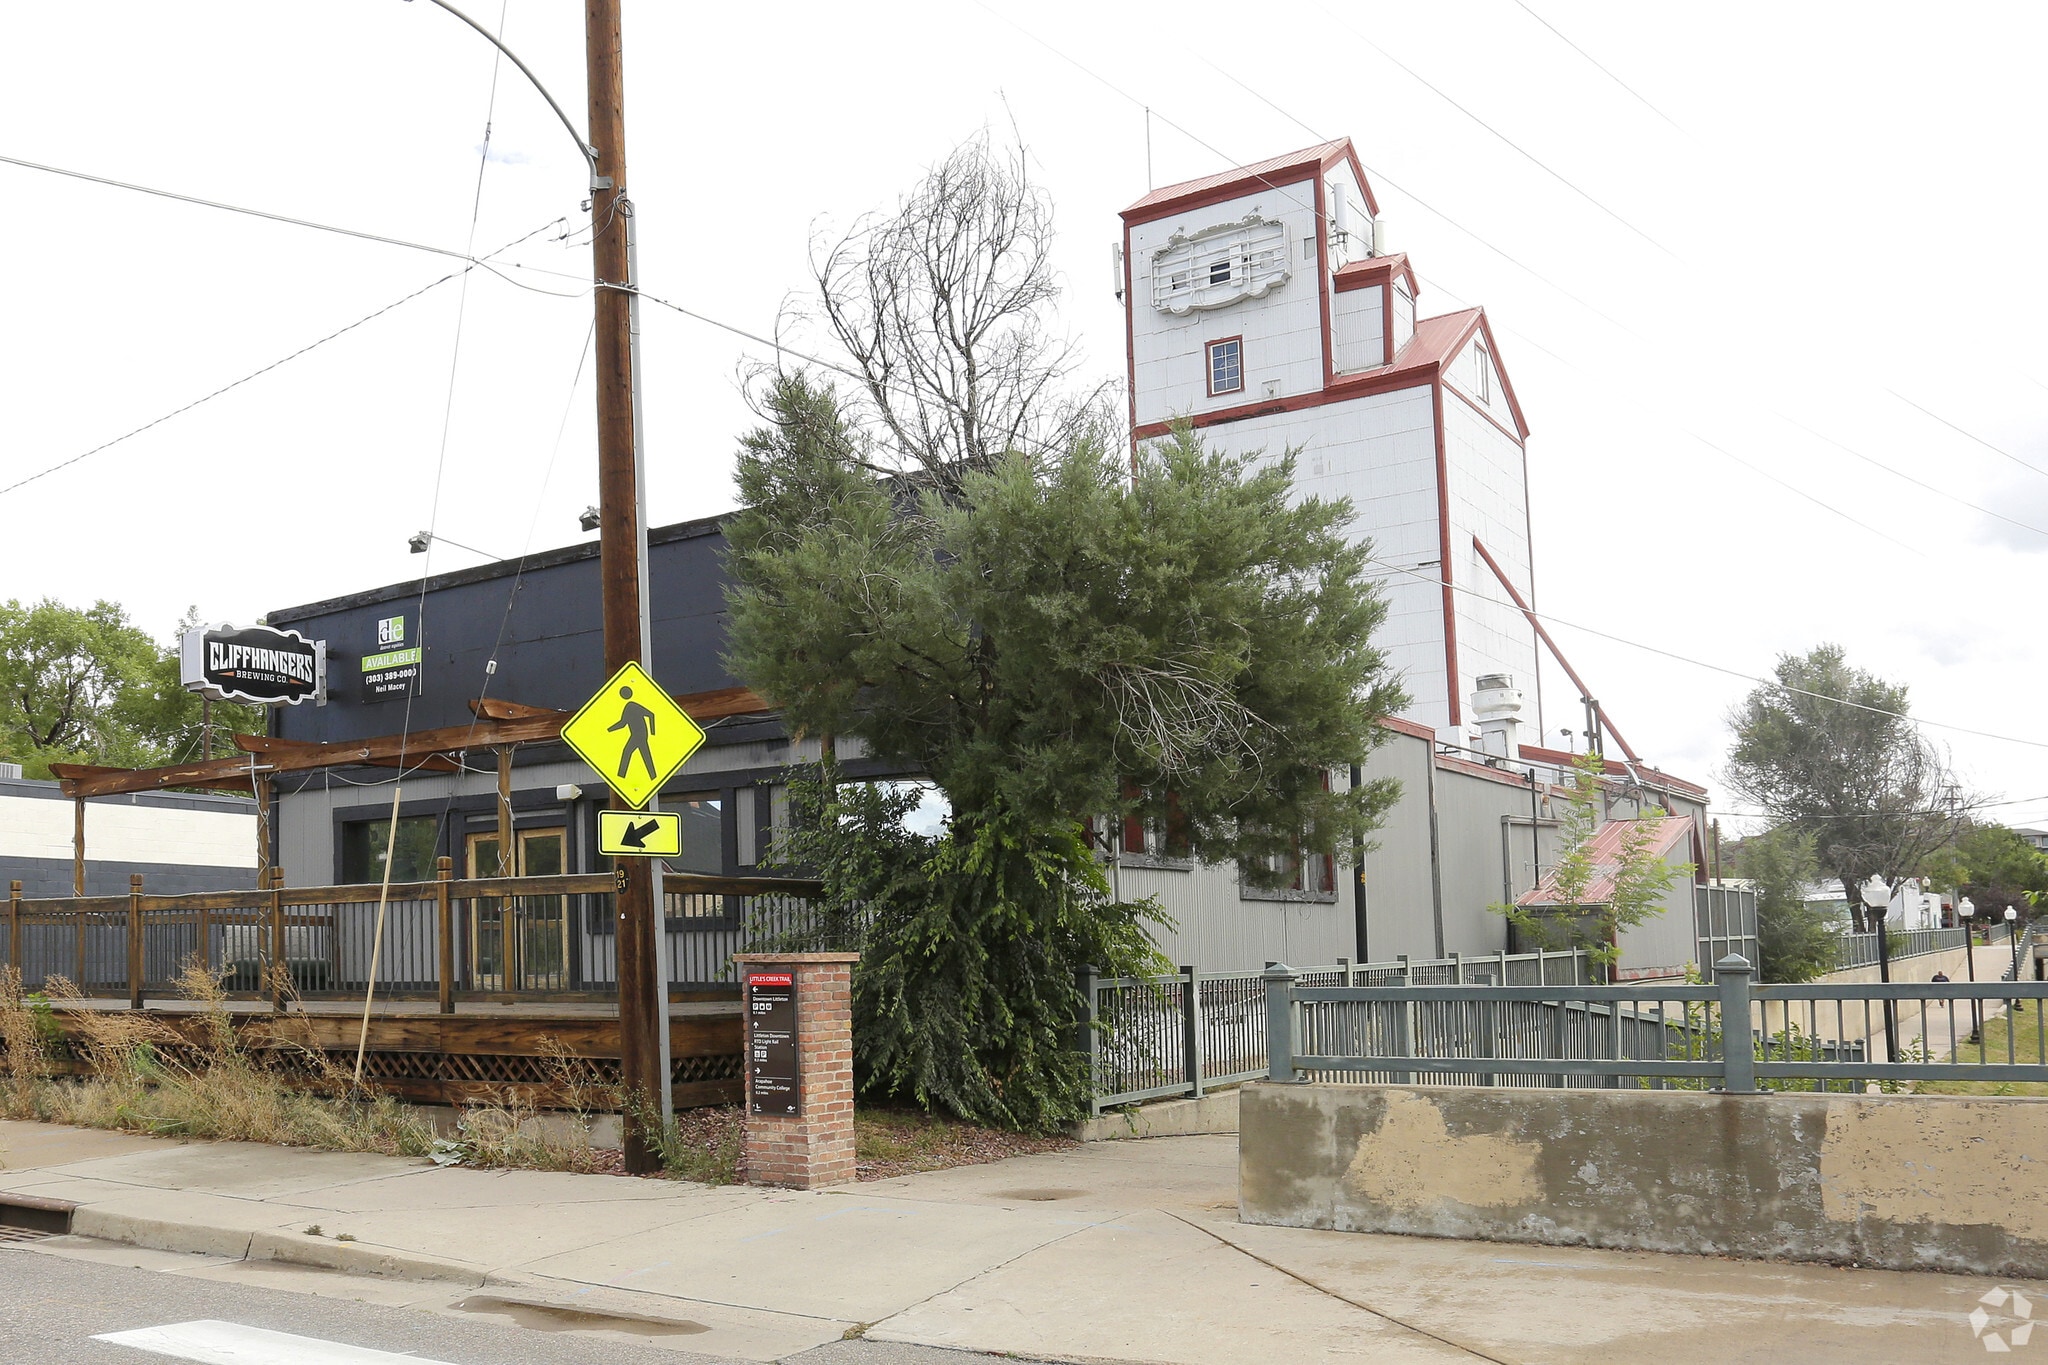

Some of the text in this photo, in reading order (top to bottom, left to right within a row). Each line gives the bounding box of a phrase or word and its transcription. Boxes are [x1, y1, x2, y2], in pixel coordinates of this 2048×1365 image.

[208, 641, 313, 684] CLIFFHANGERS
[366, 650, 418, 669] AVAILABLE
[236, 670, 288, 684] BREWING CO.
[365, 668, 418, 685] (303) 389-0000
[375, 683, 406, 694] Neil Macey
[617, 869, 625, 878] 19
[617, 879, 625, 889] 21
